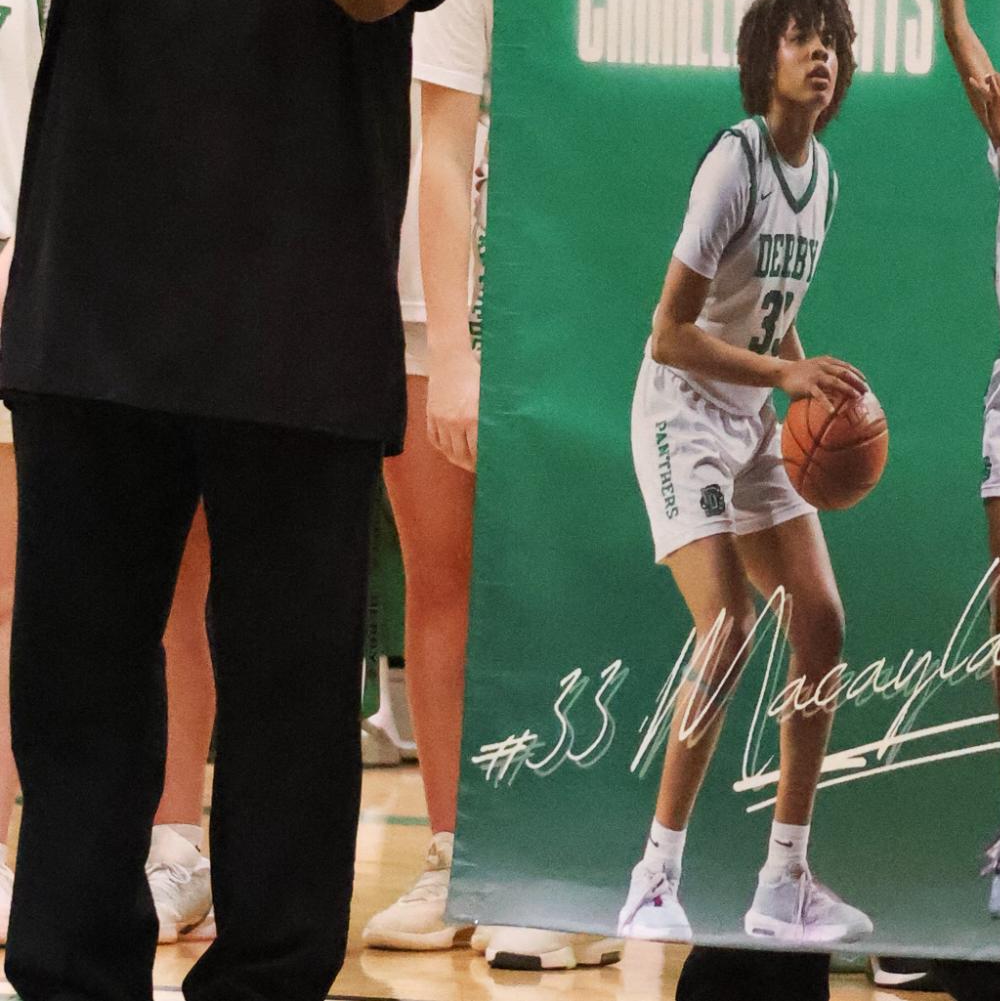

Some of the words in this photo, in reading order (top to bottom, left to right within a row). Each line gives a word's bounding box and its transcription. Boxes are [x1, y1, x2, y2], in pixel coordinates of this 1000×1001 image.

[754, 233, 819, 283] DERBY
[655, 419, 680, 520] PANTHERS
[470, 659, 626, 786] #33
